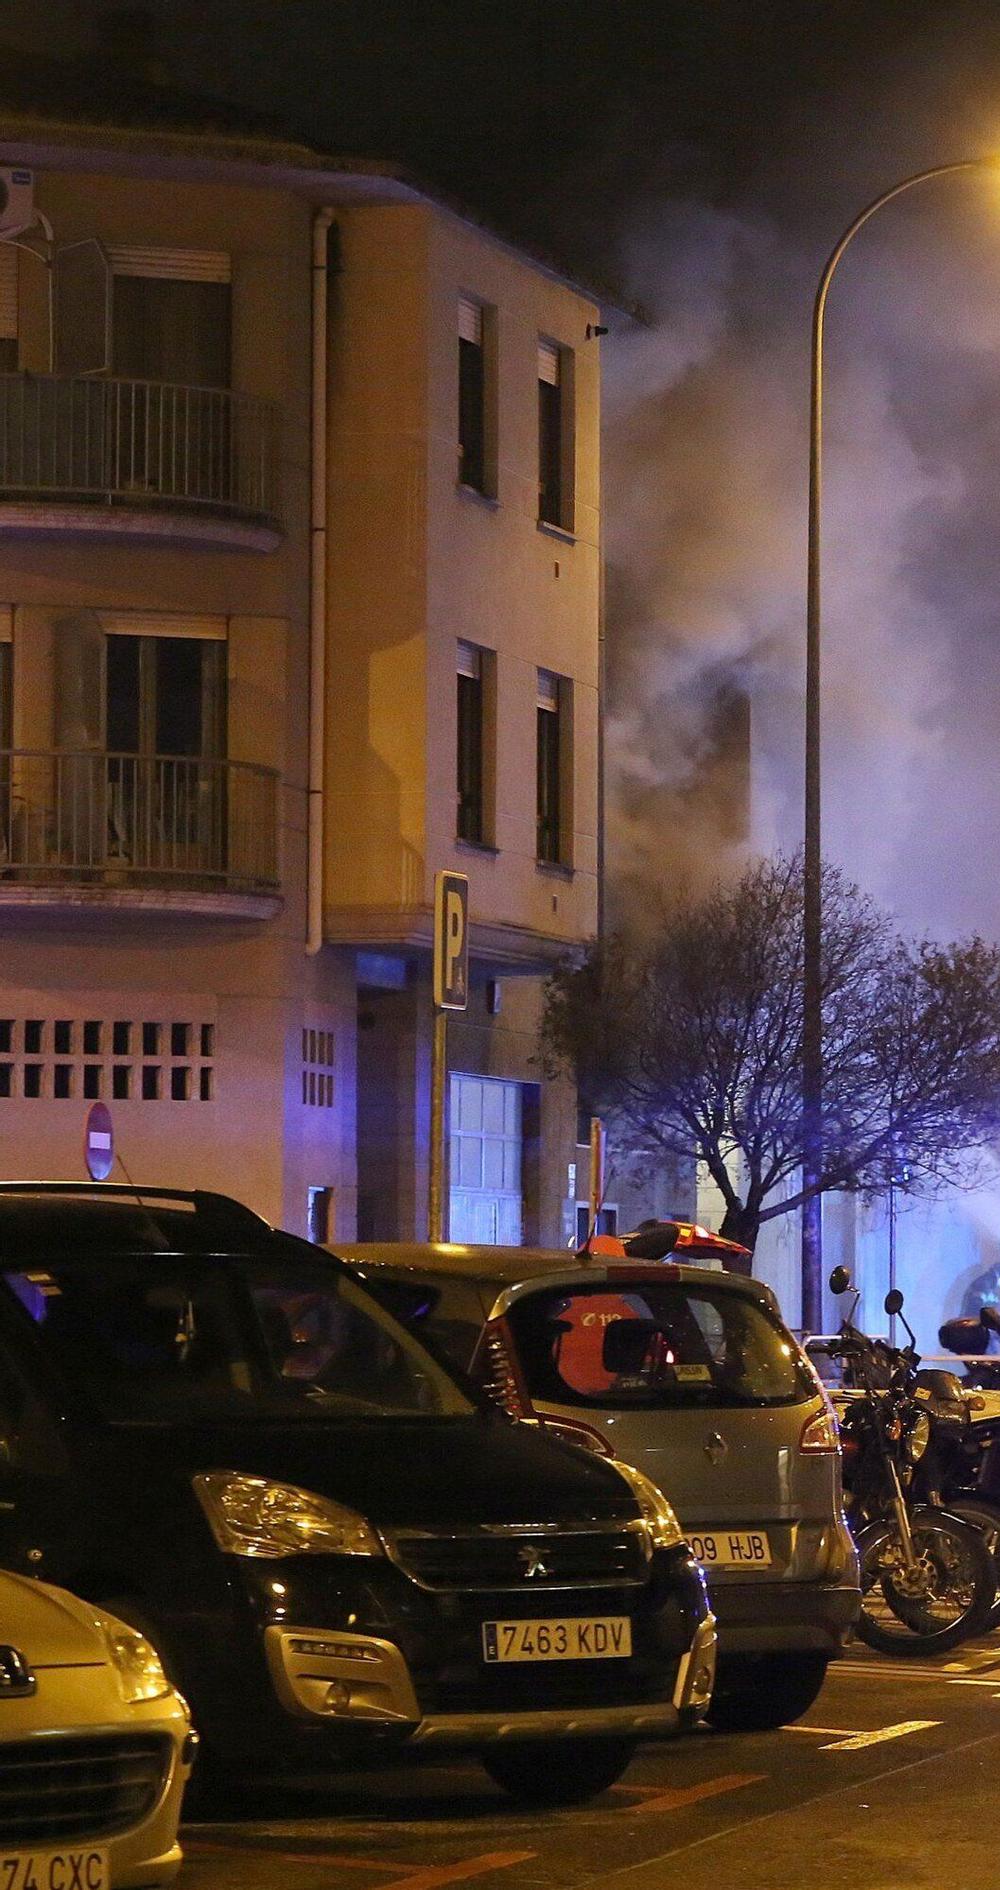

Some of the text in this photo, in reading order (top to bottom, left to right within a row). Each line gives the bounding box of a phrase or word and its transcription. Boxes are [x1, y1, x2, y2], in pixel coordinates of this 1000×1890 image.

[446, 890, 464, 990] P
[728, 1535, 765, 1560] HJB
[503, 1625, 568, 1656] 7463
[577, 1623, 623, 1653] KDV
[3, 1853, 102, 1890] 74 CXC
